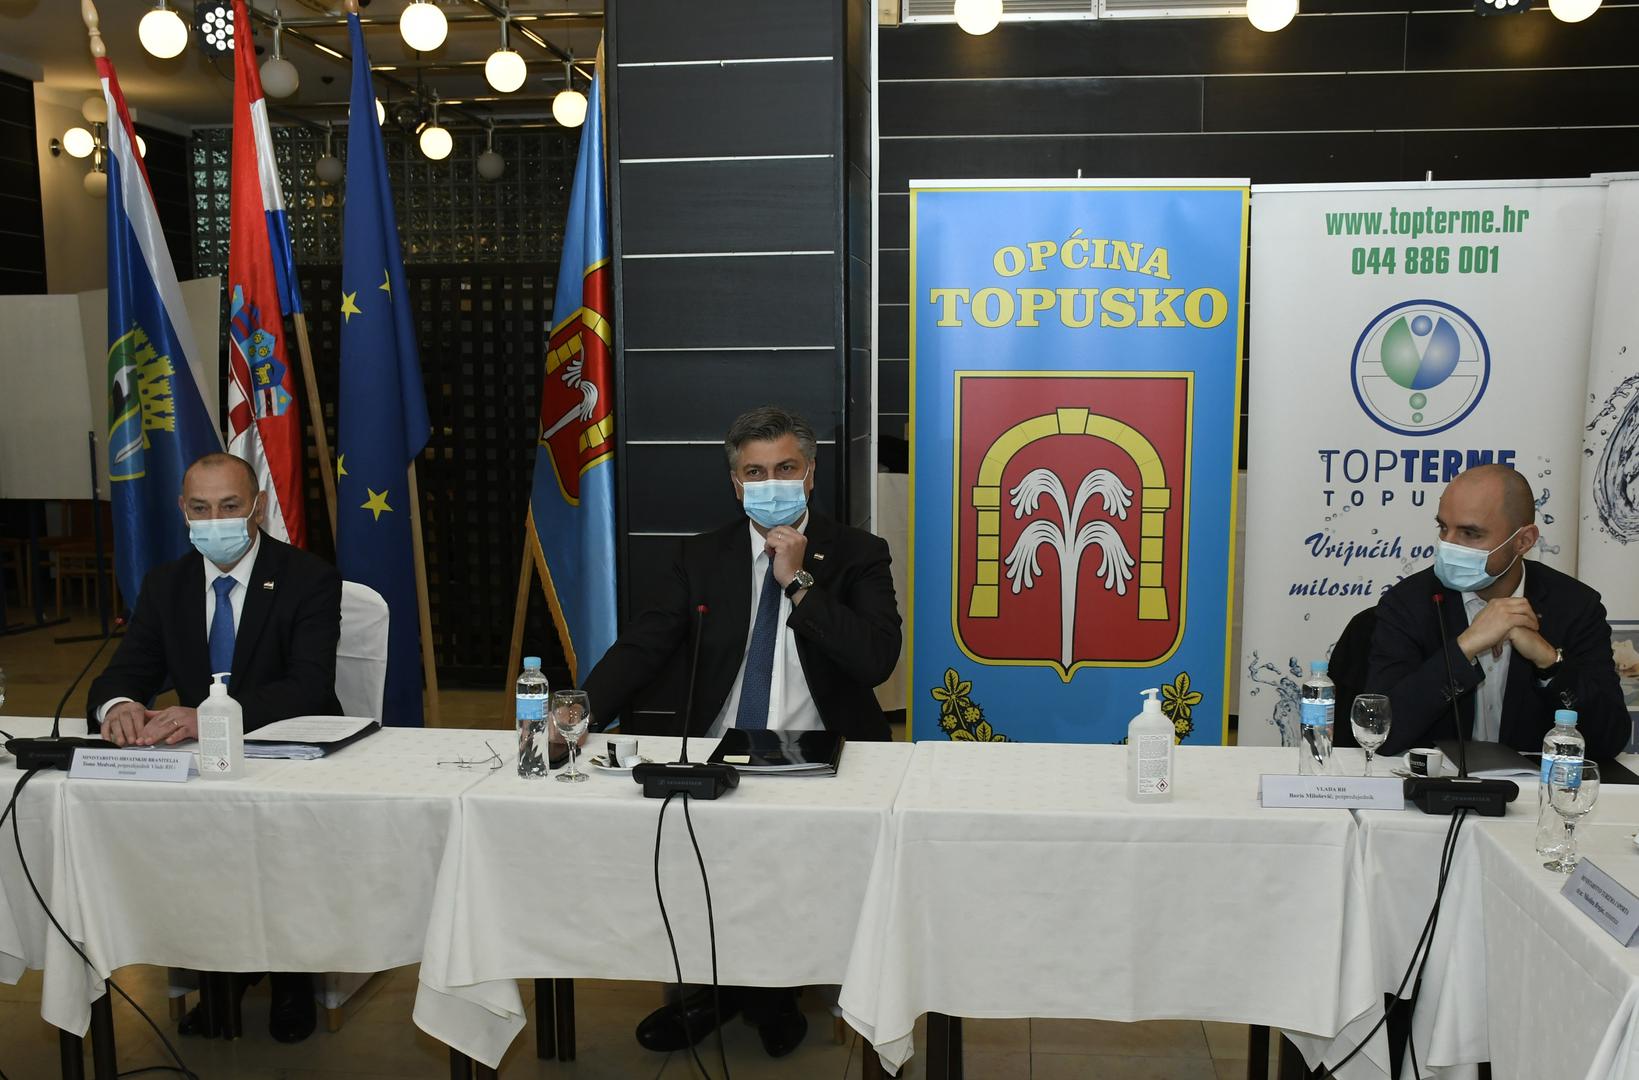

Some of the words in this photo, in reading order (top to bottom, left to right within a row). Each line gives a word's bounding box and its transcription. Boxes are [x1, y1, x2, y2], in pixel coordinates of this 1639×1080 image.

[1326, 205, 1530, 239] www.topterme.hr
[993, 227, 1172, 280] OPĆINA
[1352, 247, 1396, 275] 044
[1405, 246, 1449, 274] 886
[1459, 246, 1499, 274] 001
[929, 287, 1229, 329] TOPUSKO
[1323, 490, 1425, 507] TOPU
[1305, 532, 1402, 566] Vrijućih
[1410, 543, 1434, 559] vo
[1289, 577, 1373, 597] milosni
